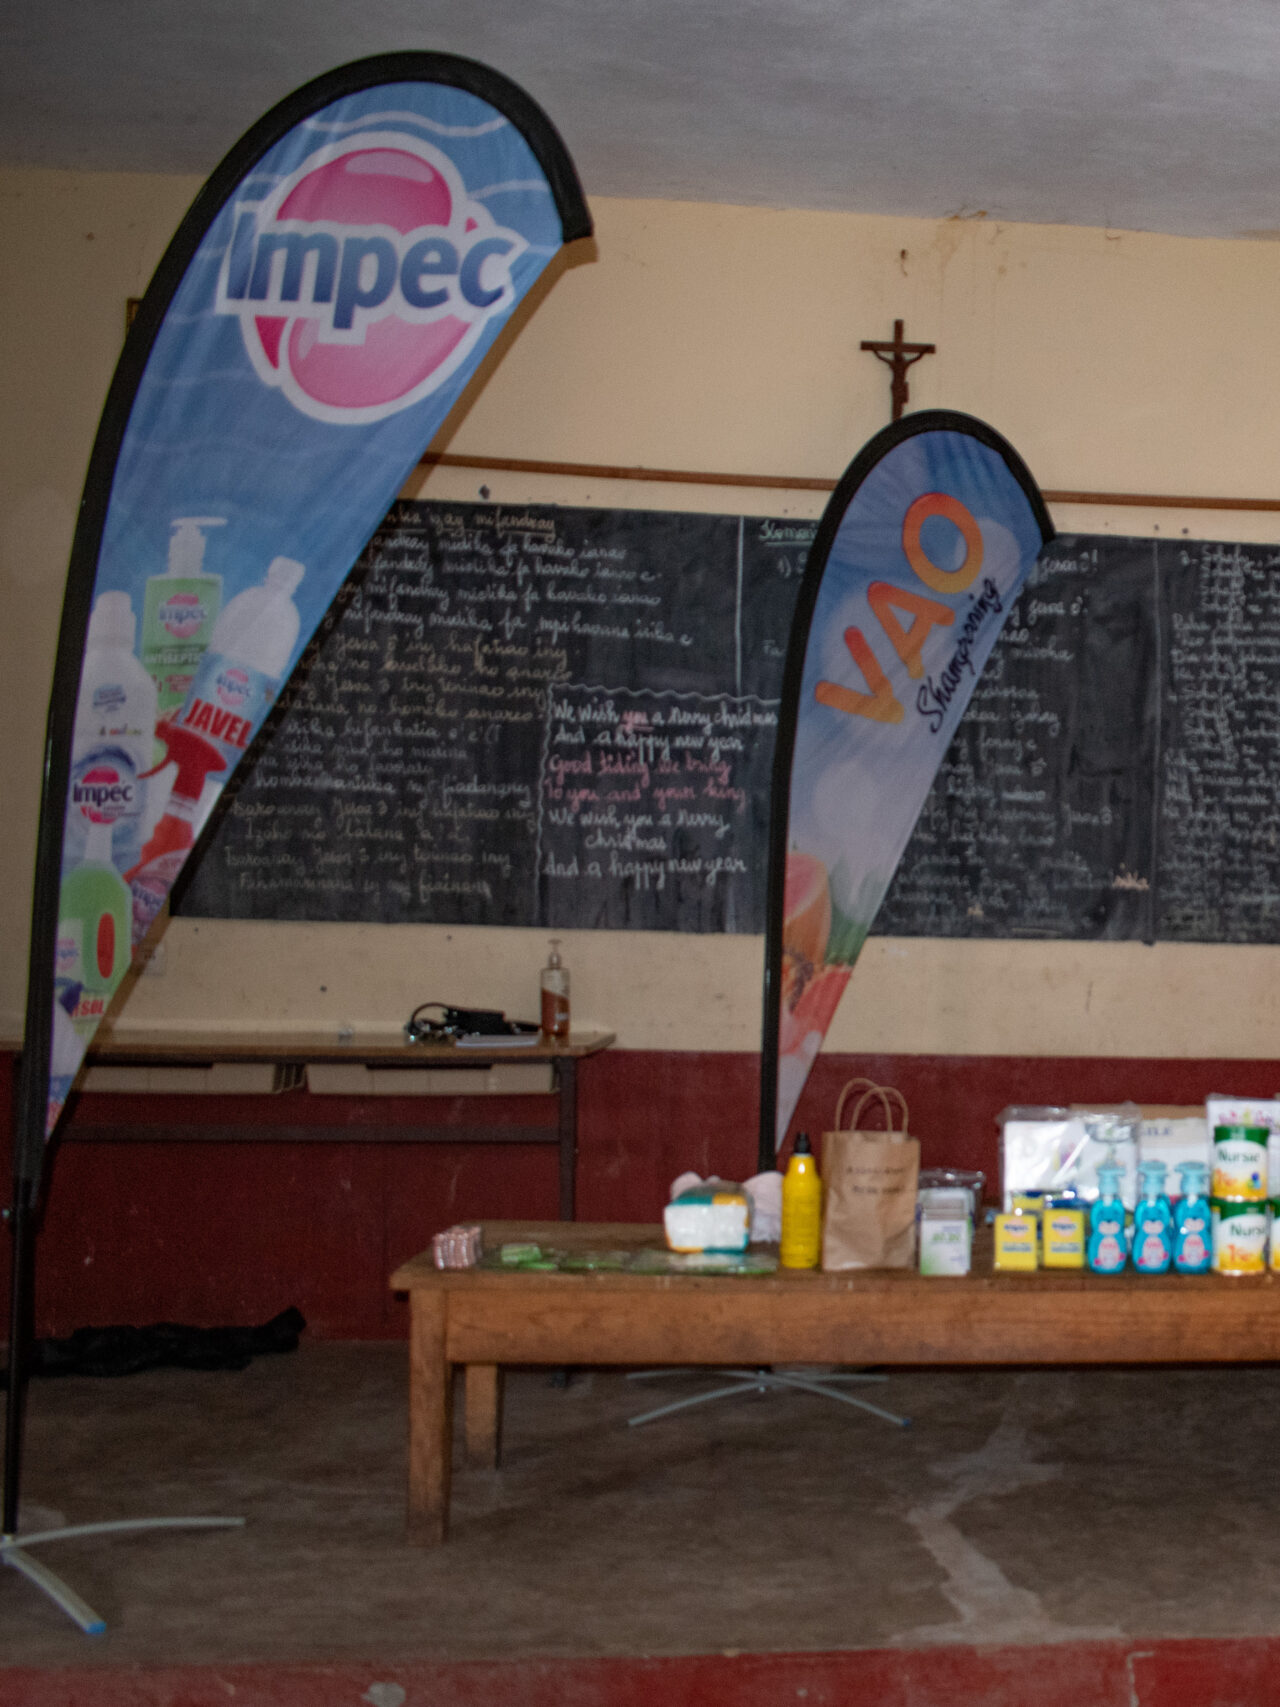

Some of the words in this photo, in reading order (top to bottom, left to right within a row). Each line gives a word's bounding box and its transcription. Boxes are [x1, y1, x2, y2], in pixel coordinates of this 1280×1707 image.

[226, 210, 512, 330] Impec
[815, 492, 983, 723] VAO
[184, 698, 252, 750] JAVEL
[73, 783, 133, 807] Impec
